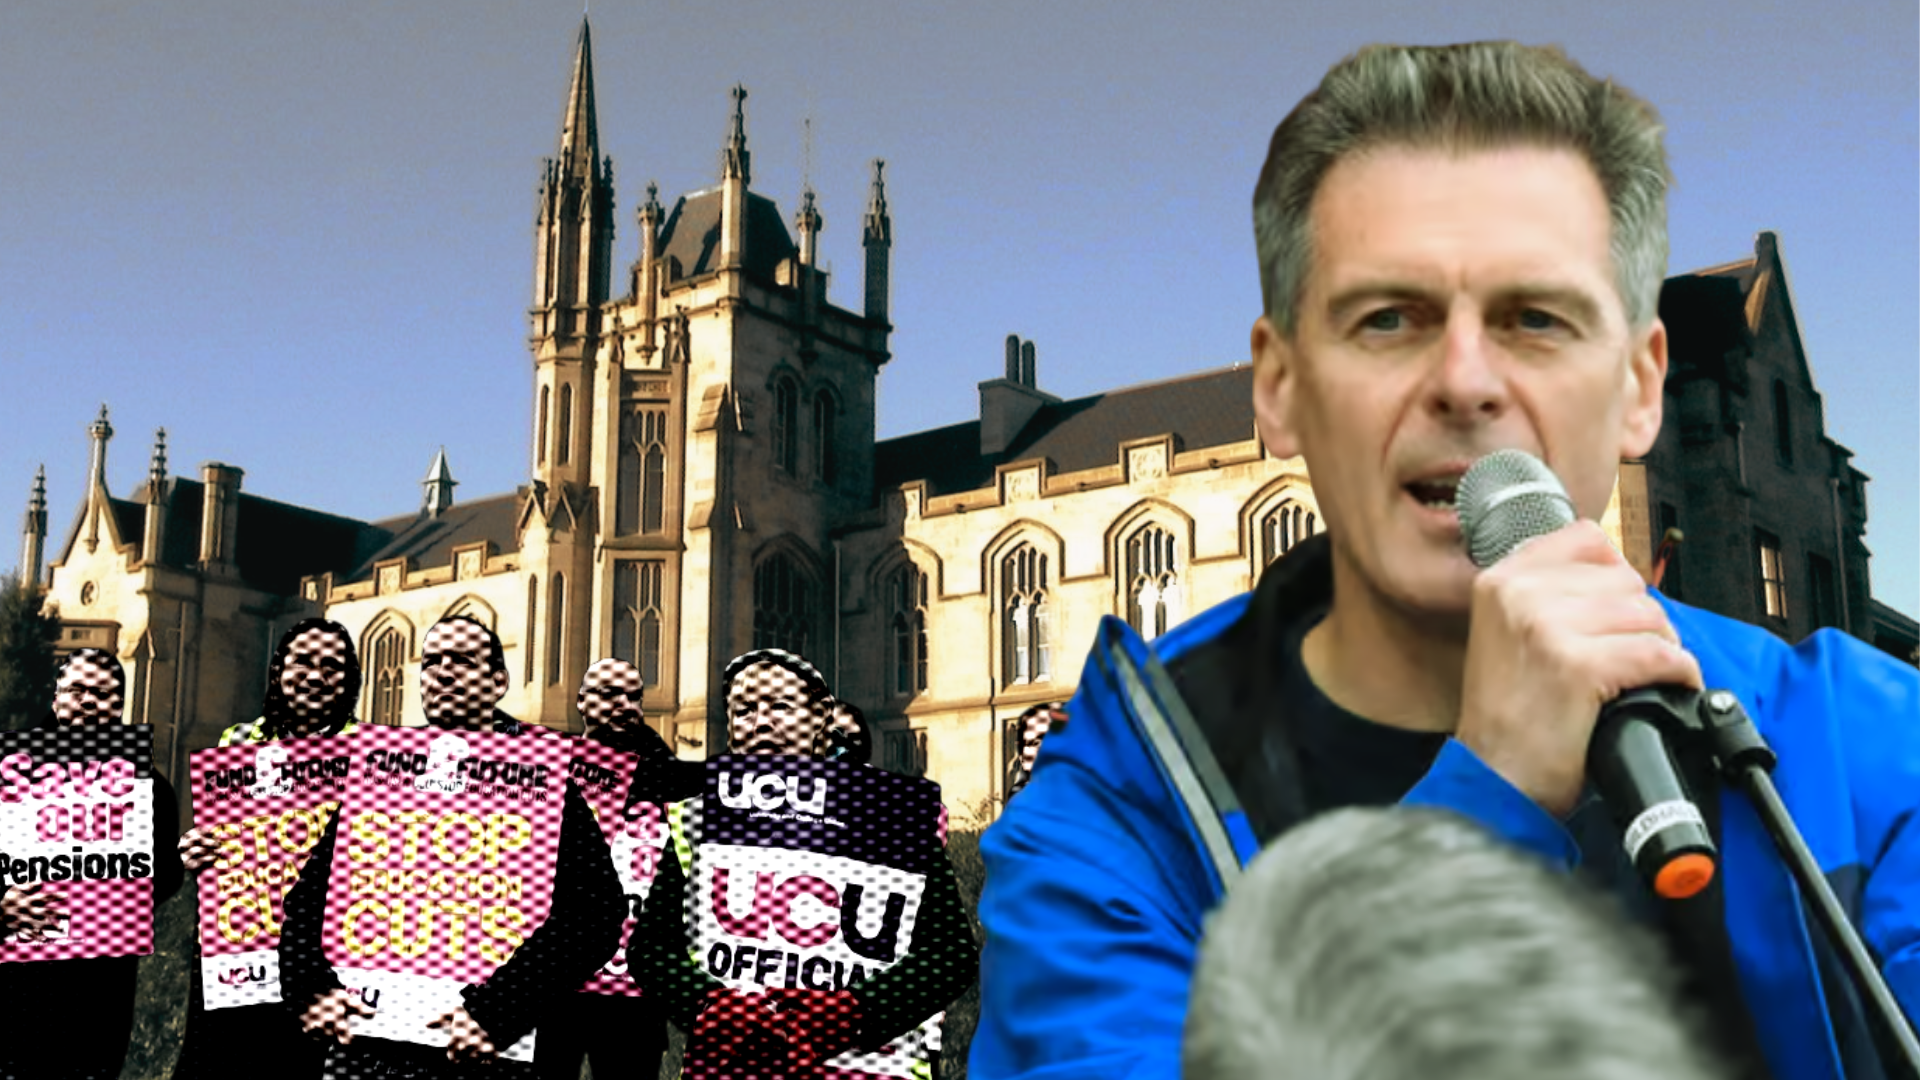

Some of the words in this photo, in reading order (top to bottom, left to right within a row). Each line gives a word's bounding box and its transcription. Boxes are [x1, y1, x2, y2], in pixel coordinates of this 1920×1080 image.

[36, 801, 134, 843] our
[348, 810, 532, 869] STOP
[217, 861, 300, 893] EDUCA
[350, 868, 522, 901] EDUCATION
[342, 898, 526, 965] CUTS
[707, 942, 882, 992] OFFICIA
